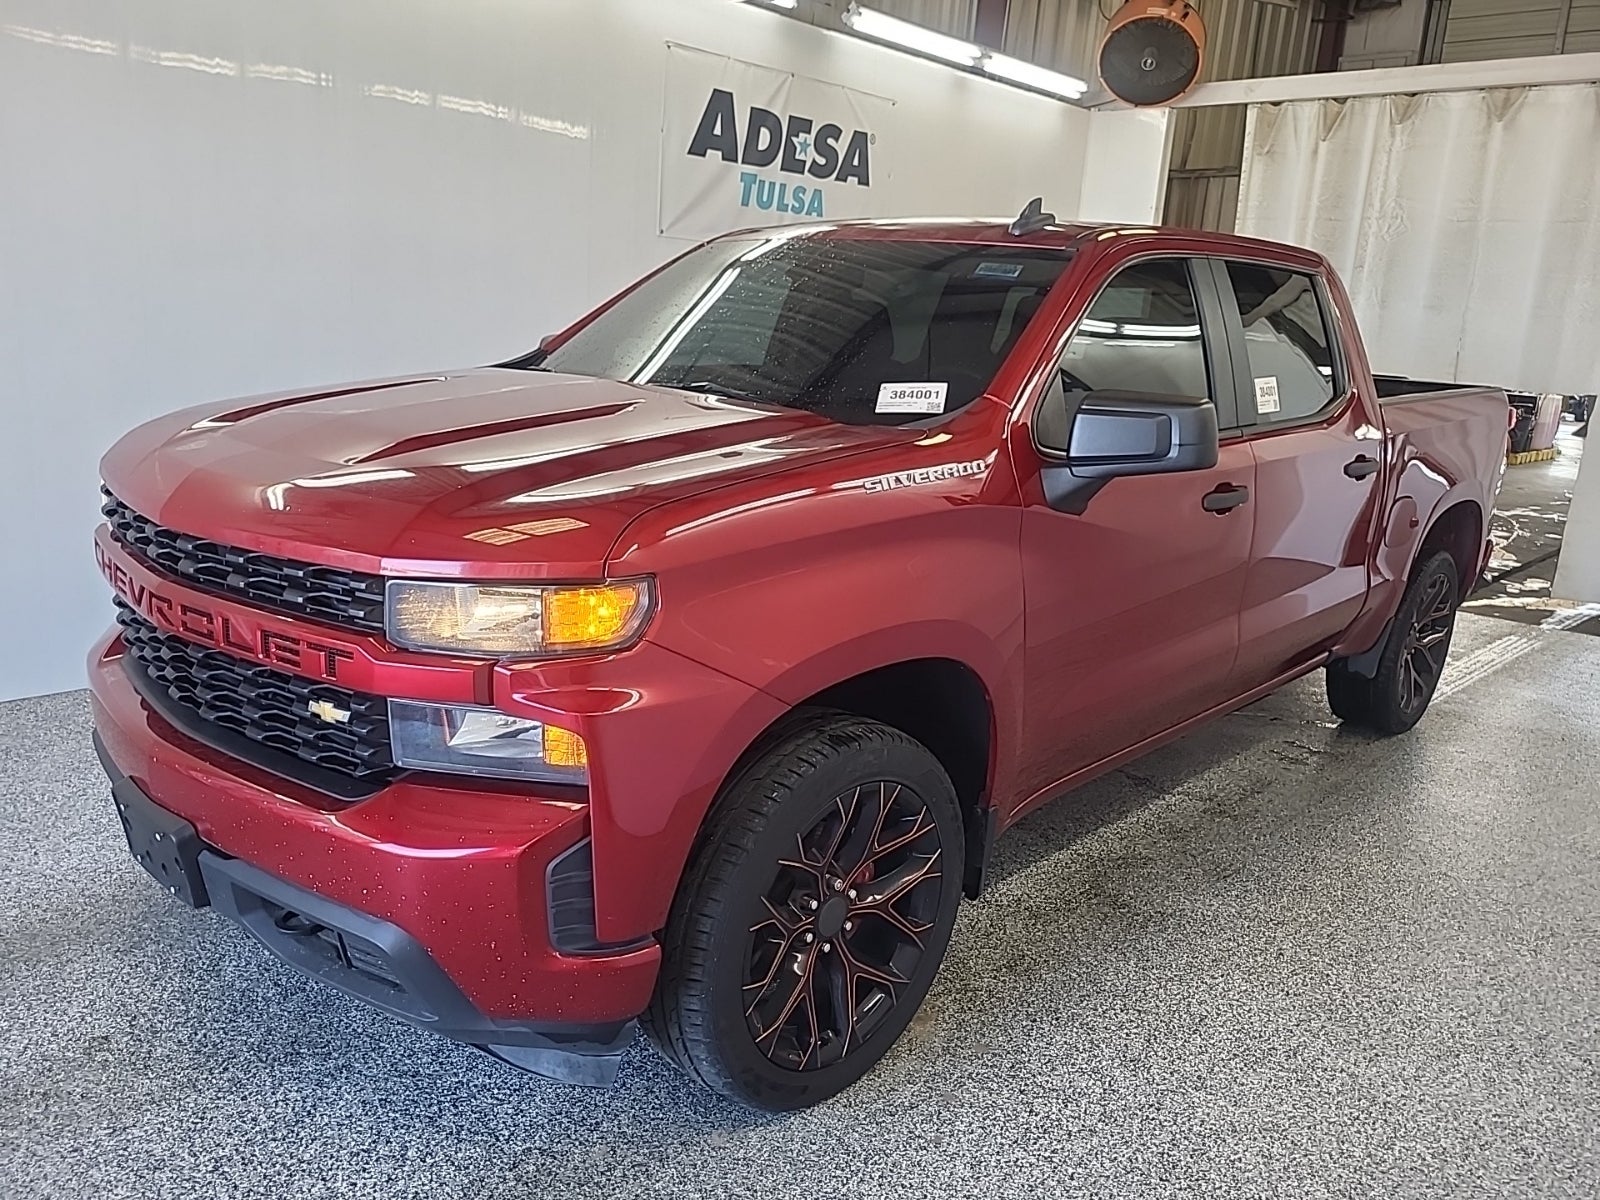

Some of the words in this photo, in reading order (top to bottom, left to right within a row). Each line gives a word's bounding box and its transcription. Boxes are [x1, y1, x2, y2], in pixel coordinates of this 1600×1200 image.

[687, 88, 870, 187] ADESA
[740, 171, 823, 217] TULSA
[889, 390, 940, 400] 384001
[863, 459, 986, 494] SILVERADO
[94, 540, 355, 681] CHEVROLET
